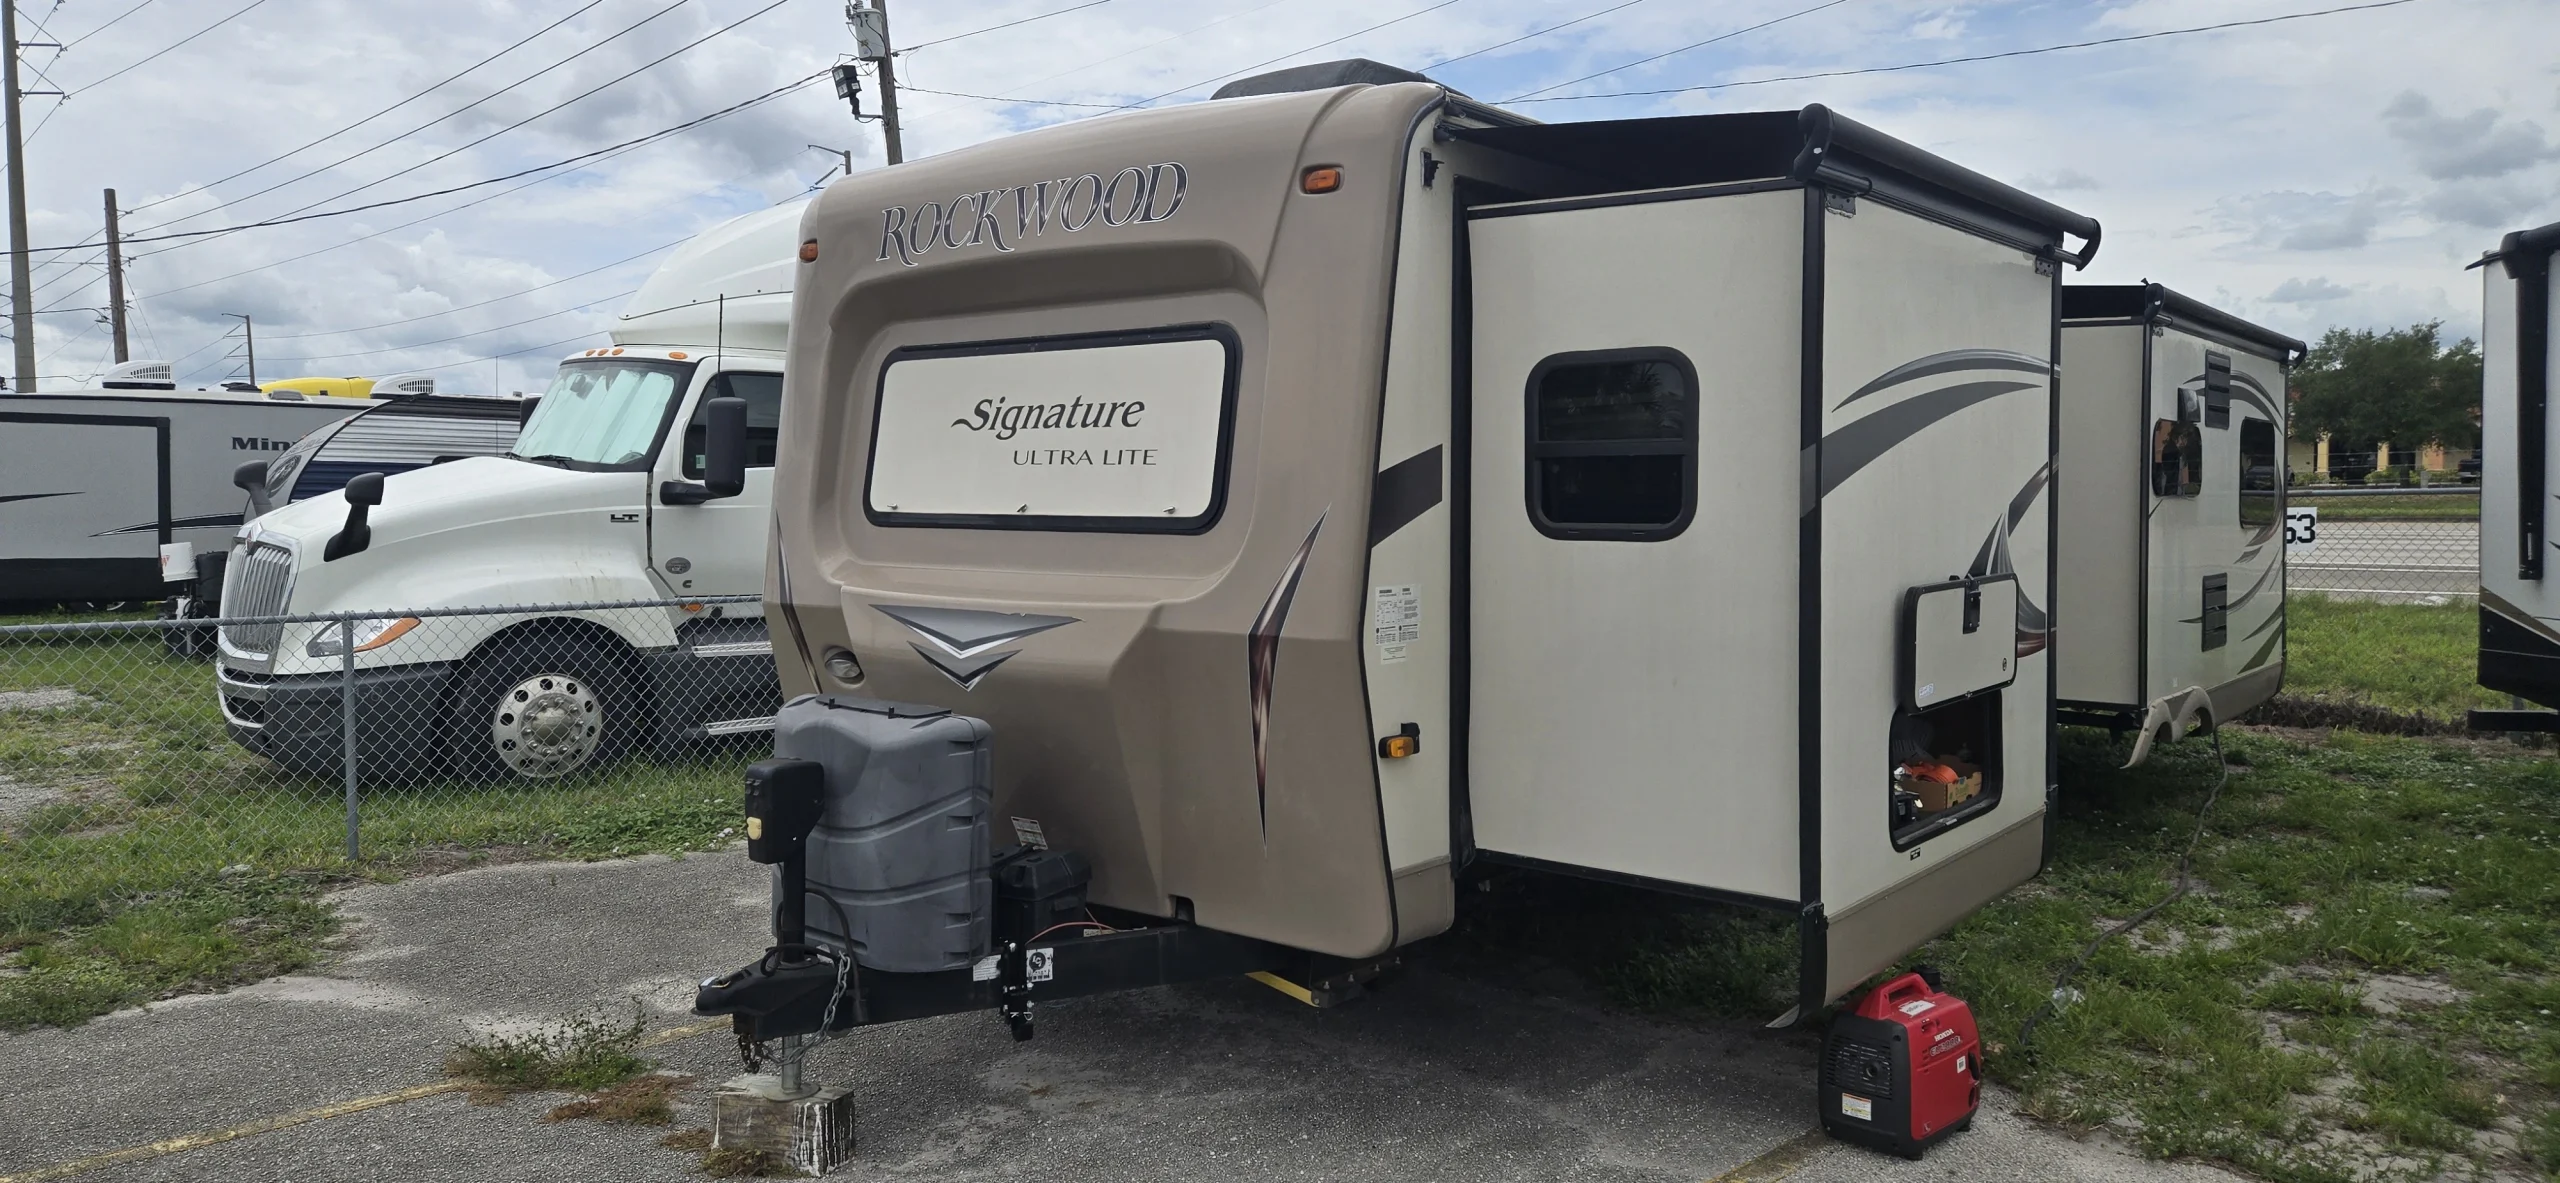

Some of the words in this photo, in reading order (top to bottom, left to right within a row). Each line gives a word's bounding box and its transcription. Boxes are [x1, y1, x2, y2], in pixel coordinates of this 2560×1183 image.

[876, 161, 1189, 267] ROCKWOOD
[950, 395, 1145, 440] Signature
[231, 436, 297, 451] Min
[1013, 449, 1093, 466] ULTRA
[1103, 449, 1158, 466] LITE
